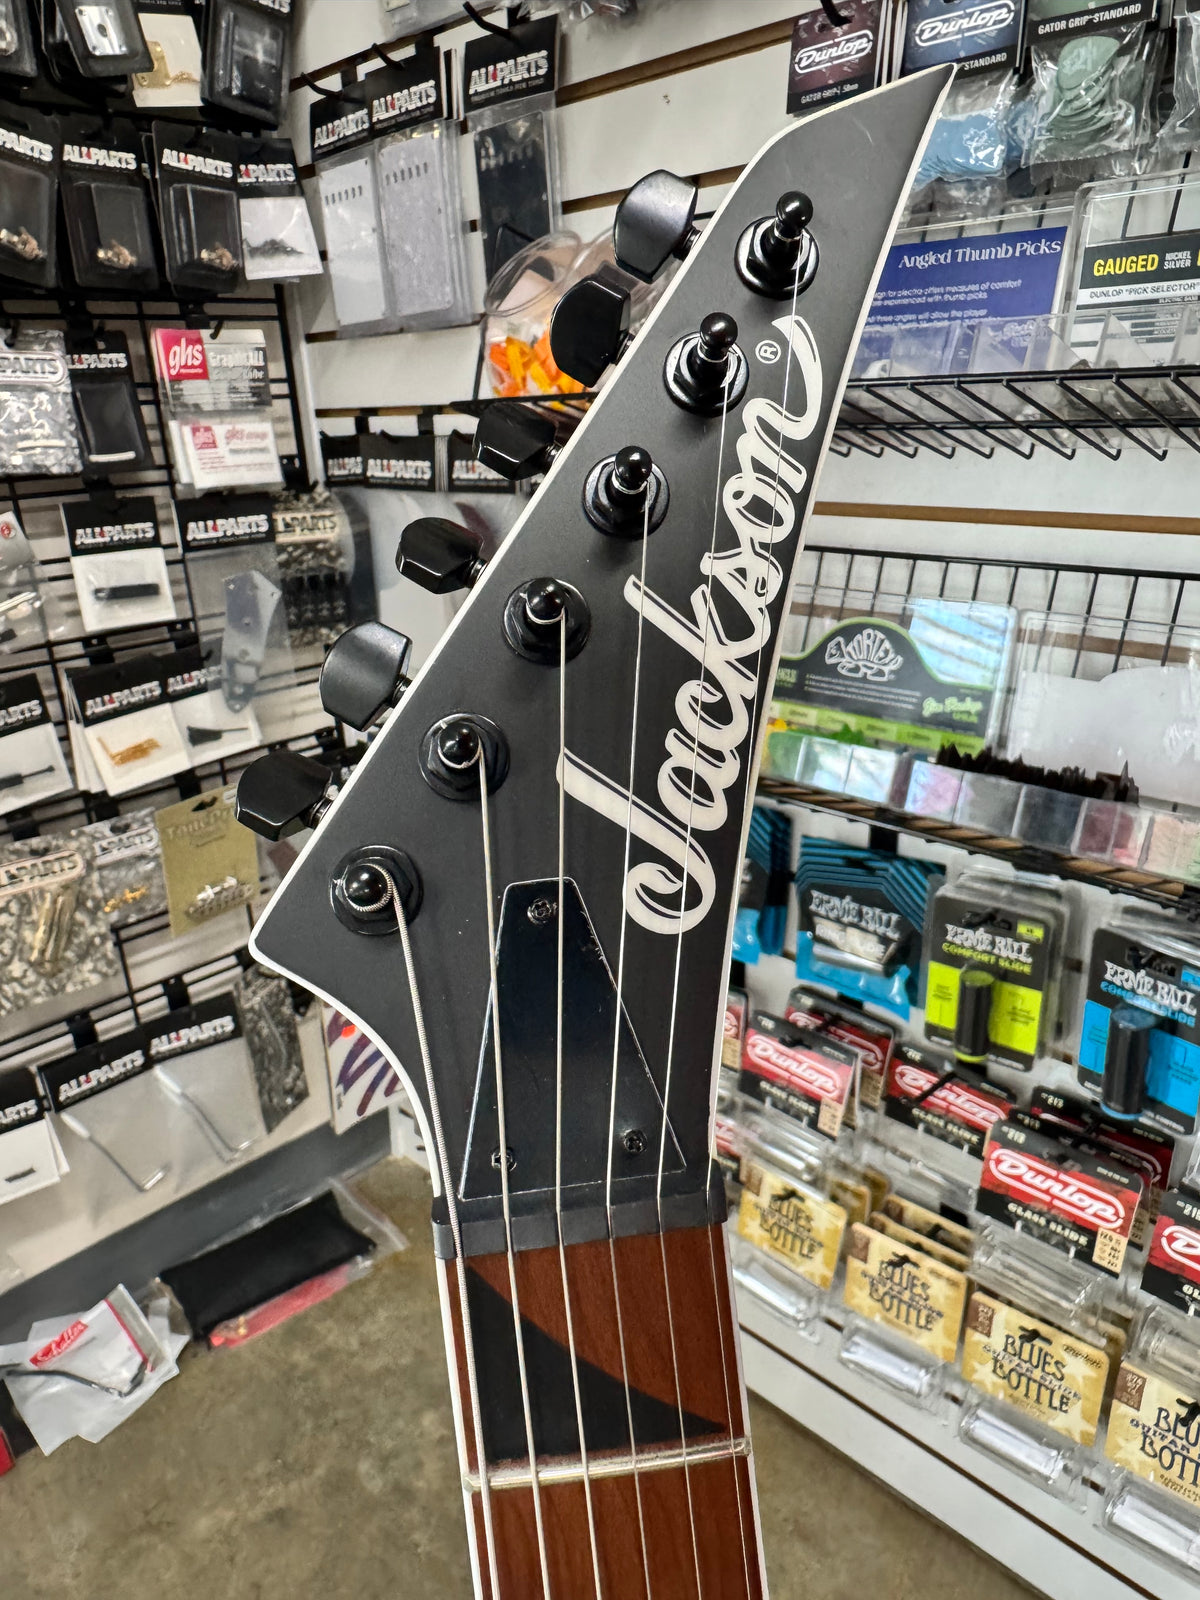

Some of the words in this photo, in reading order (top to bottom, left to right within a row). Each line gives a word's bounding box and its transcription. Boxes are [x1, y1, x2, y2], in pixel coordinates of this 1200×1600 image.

[920, 7, 1010, 41] Dunlop
[1038, 19, 1067, 35] GATOR
[1093, 3, 1142, 23] STANDARD
[798, 37, 869, 68] Dunlop
[963, 52, 1007, 71] STANDARD
[468, 50, 549, 95] ALLPARTS
[372, 79, 437, 123] ALLPARTS
[313, 107, 370, 149] ALLPARTS
[62, 144, 137, 170] ALLPARTS
[161, 148, 233, 179] ALLPARTS
[898, 248, 952, 270] Angled
[954, 243, 1013, 263] Thumb
[1015, 238, 1062, 257] Picks
[1093, 254, 1159, 276] GAUGED
[1163, 259, 1191, 270] SILVER
[1165, 250, 1191, 260] NICKEL
[65, 353, 128, 369] LLPARTS
[169, 337, 203, 376] ghs
[366, 458, 432, 480] ALLPARTS
[75, 522, 155, 546] ALLPARTS
[187, 514, 270, 541] ALLPARTS
[556, 315, 823, 934] Jackson
[85, 681, 162, 718] ALLPARTS
[1103, 960, 1154, 997] ERNIE
[1154, 979, 1198, 1017] BALL
[150, 1015, 235, 1054] ALLPARTS
[59, 1050, 146, 1102] ALLPARTS
[754, 1044, 838, 1093] Dunlop
[994, 1153, 1119, 1222] Dunlop
[1007, 1202, 1046, 1227] GLASS
[1049, 1221, 1089, 1247] SLIDE
[1002, 1333, 1068, 1382] BLUES
[991, 1354, 1072, 1415] BOTTLE
